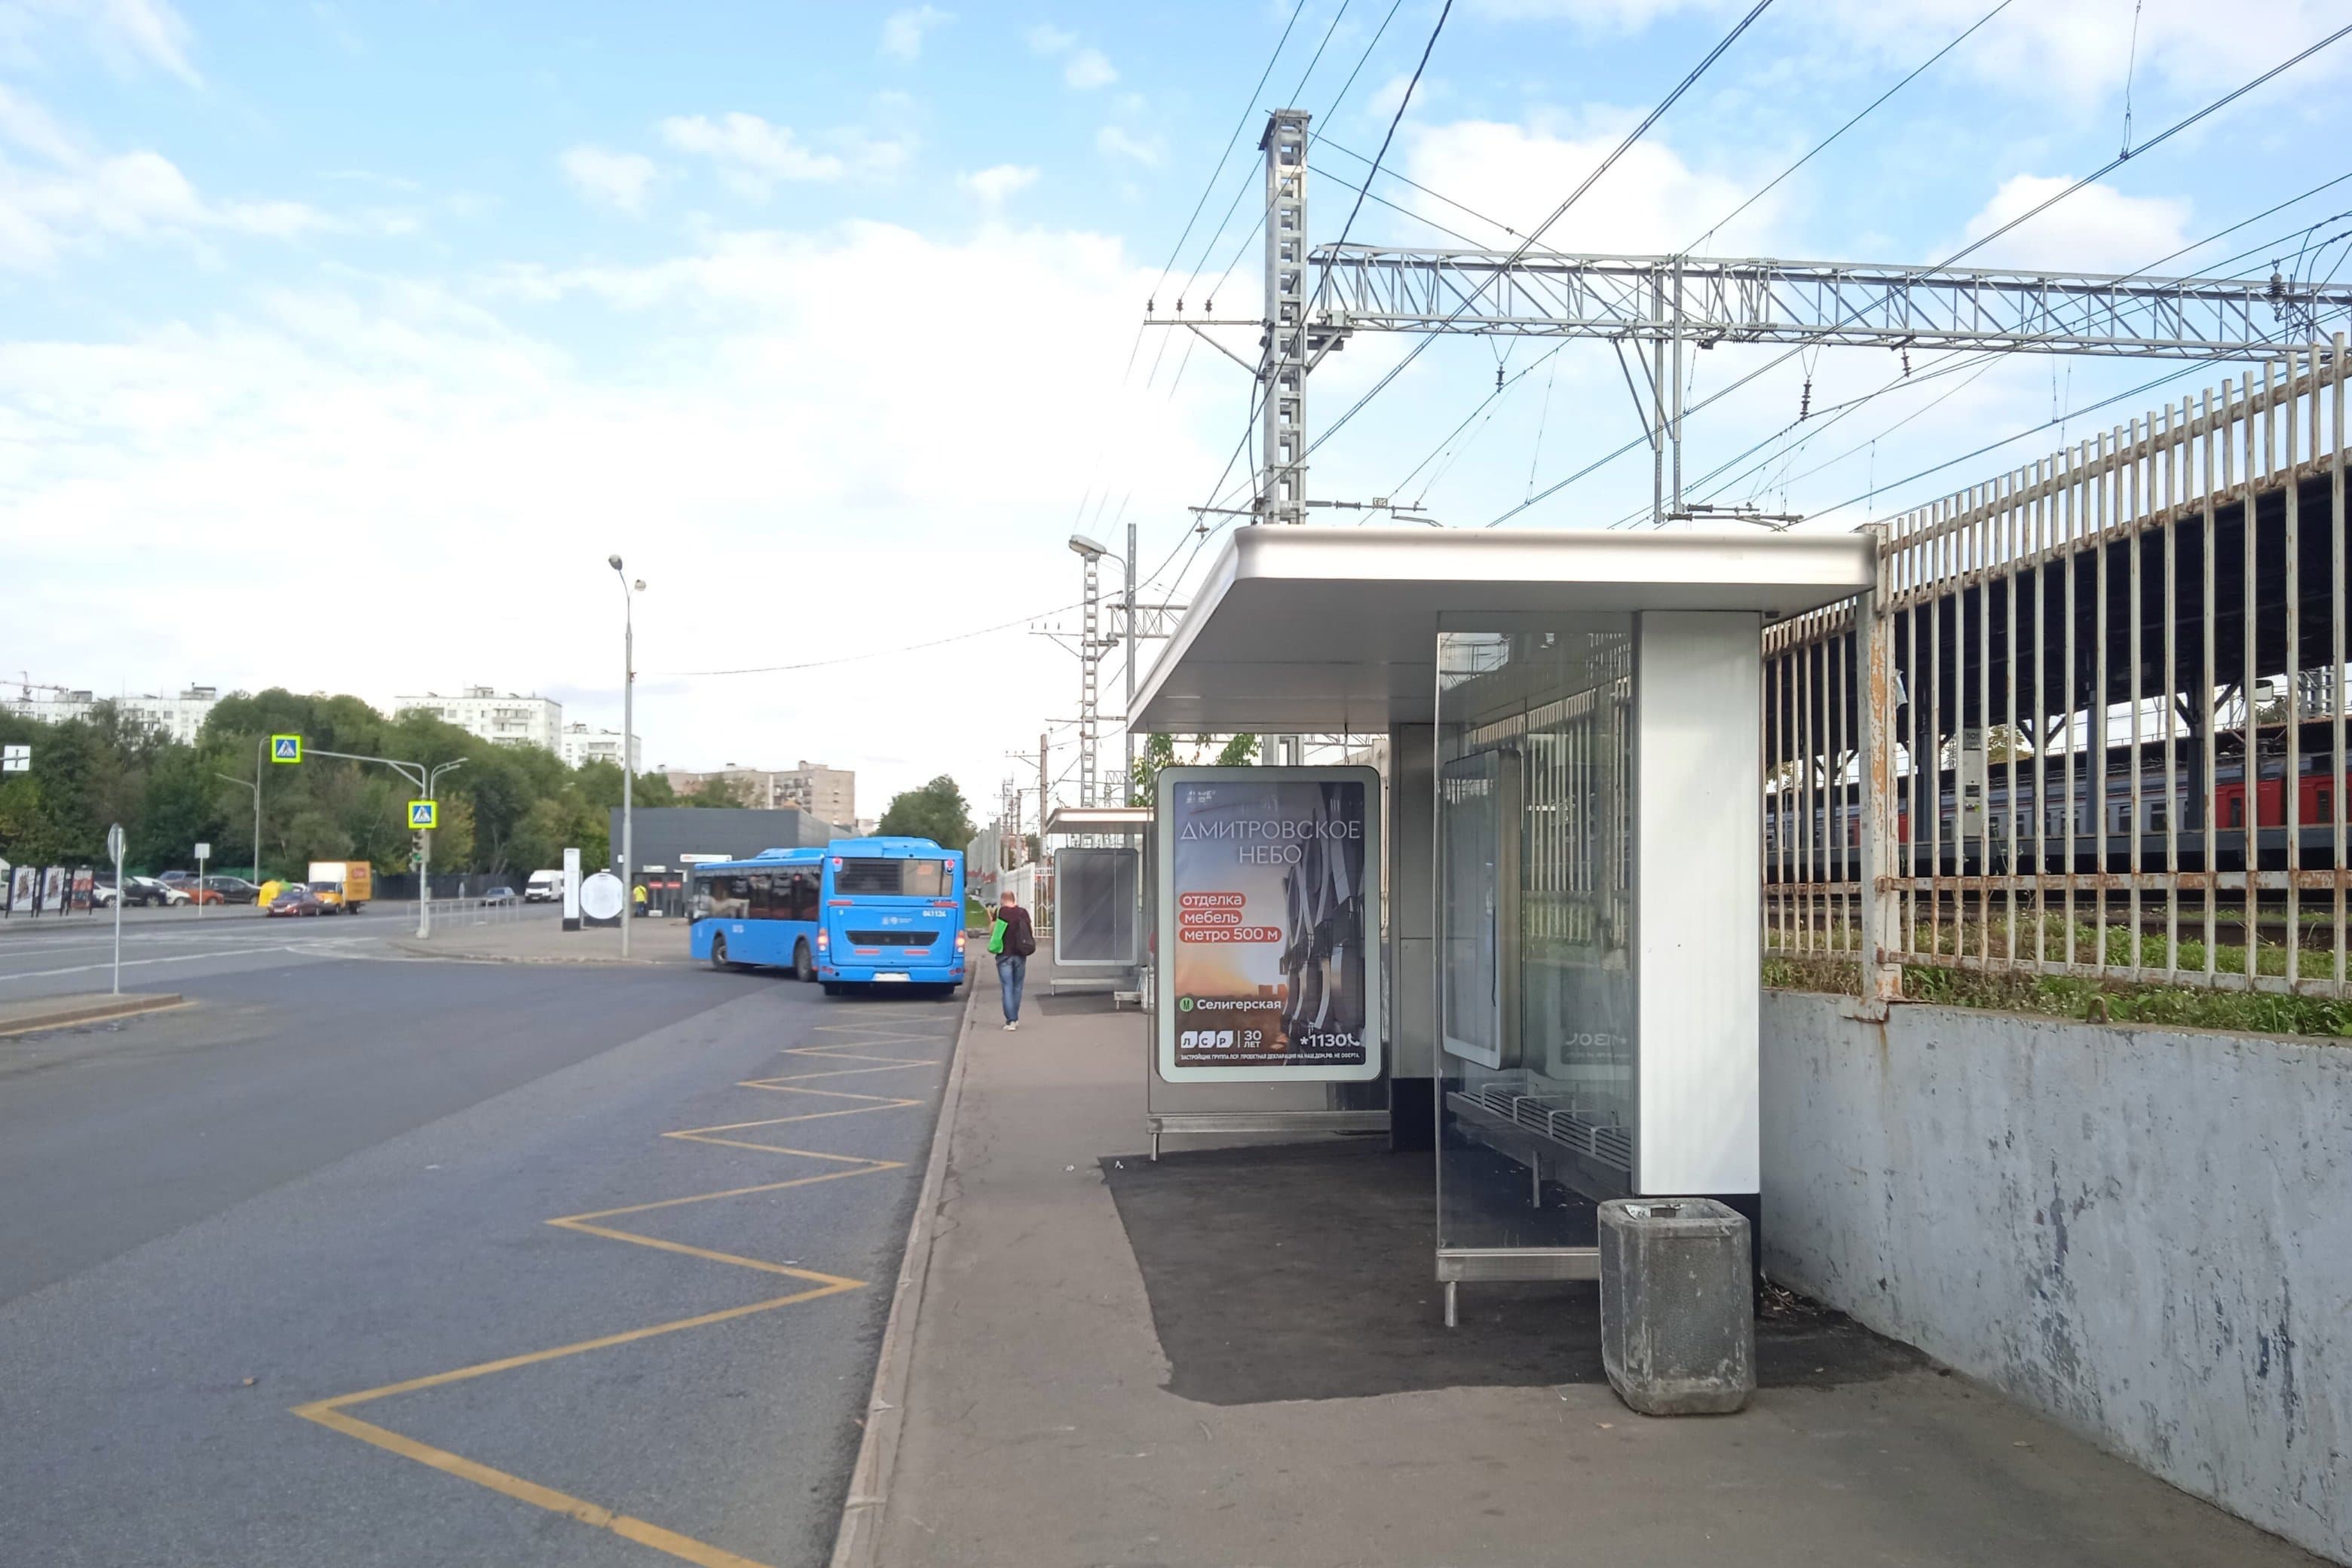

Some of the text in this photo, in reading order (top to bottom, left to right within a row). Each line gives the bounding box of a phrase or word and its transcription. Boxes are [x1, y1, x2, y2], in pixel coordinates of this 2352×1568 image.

[1180, 820, 1361, 841] ДМИТРОВСКОЕ
[1239, 844, 1303, 864] НЕБО
[1182, 896, 1242, 907] отделка
[1184, 911, 1239, 923] мебель
[1184, 928, 1278, 942] метро 500 м
[1196, 999, 1282, 1012] Селигерская
[1244, 1030, 1263, 1040] 30
